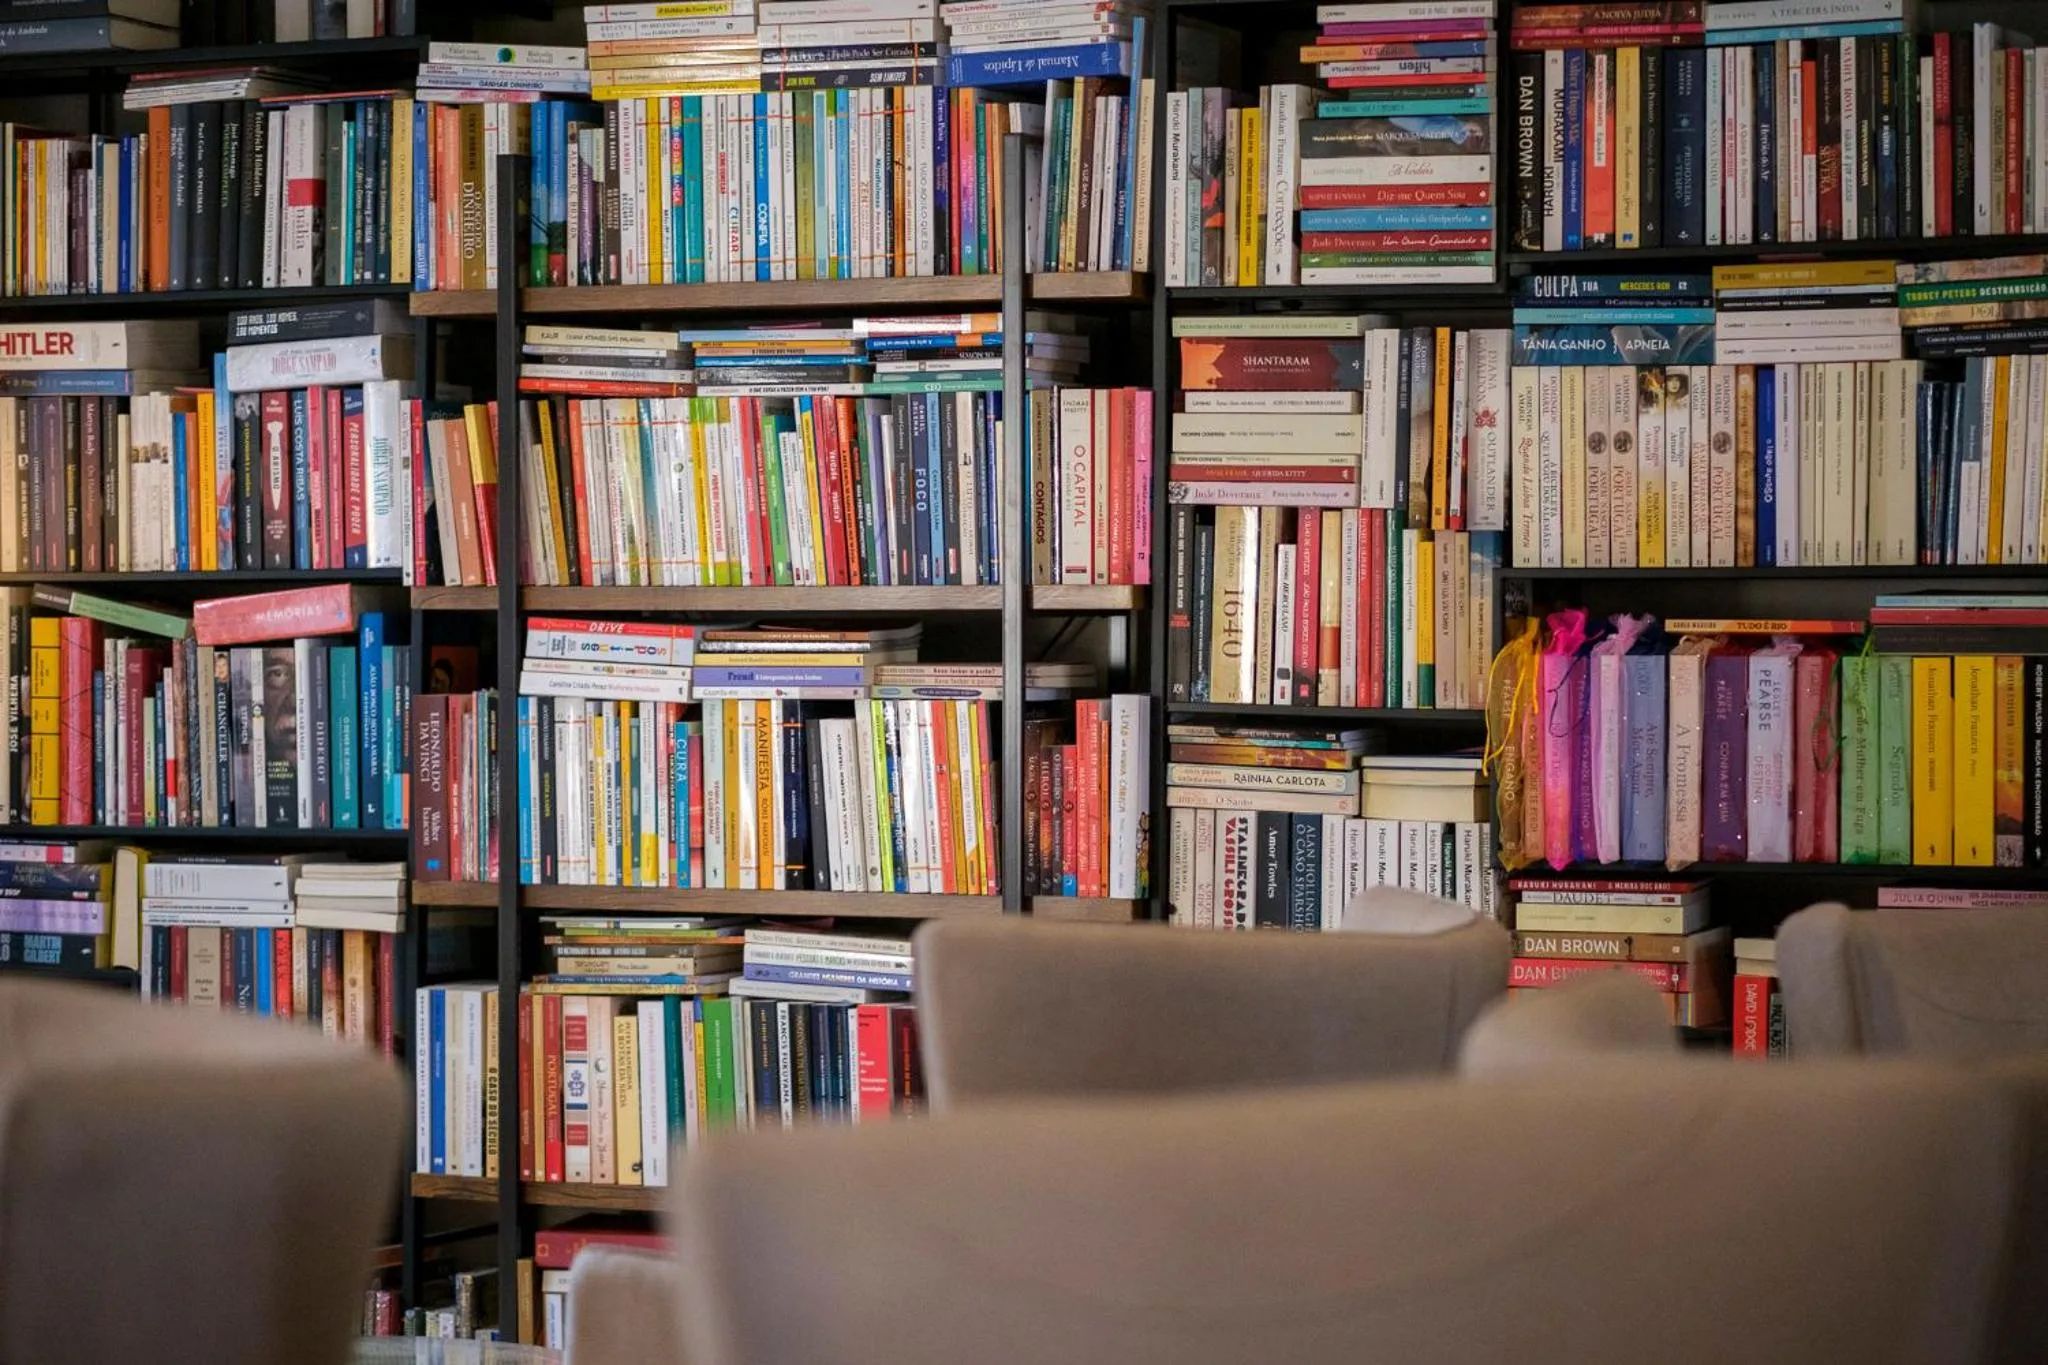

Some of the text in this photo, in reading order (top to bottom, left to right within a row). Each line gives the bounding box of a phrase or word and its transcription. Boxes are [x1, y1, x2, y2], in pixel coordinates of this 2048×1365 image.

[1519, 75, 1534, 178] DAN BROWN
[1553, 88, 1564, 163] MURAKAMI
[463, 181, 475, 259] DINHEIRO
[1543, 166, 1554, 218] HARUKI
[1534, 275, 1599, 298] CULPA TUA
[1242, 355, 1311, 367] SHANTARAM
[1559, 339, 1671, 351] GANHO APNEIA
[914, 467, 928, 512] FOCO
[1073, 461, 1087, 527] CAPITAL
[1486, 431, 1497, 512] OUTLANDER
[1587, 465, 1599, 541] PORTUGAL
[1034, 480, 1047, 545] CONTÁGIOS
[1612, 465, 1625, 543] PORTUGAL
[1712, 465, 1724, 545] PORTUGAL
[1221, 588, 1245, 659] 1640
[9, 674, 19, 723] VILHENA
[1758, 669, 1772, 732] PEARSE
[316, 721, 326, 784] DIDEROT
[430, 711, 441, 793] LEONARDO
[676, 739, 688, 783] CURA
[758, 716, 770, 792] MANIFESTA
[1233, 773, 1326, 787] RAINHA CARLOTA
[1503, 745, 1515, 801] ENGANO
[1676, 743, 1692, 822] Promessa
[1267, 827, 1279, 899] Amor Towles
[1295, 838, 1306, 872] CASO
[1306, 824, 1316, 858] ALAN
[1514, 964, 1547, 981] DAN
[1524, 938, 1620, 955] DAN BROWN
[547, 1054, 559, 1115] PORTUGAL
[778, 1009, 791, 1105] FRANCIS FUKUYAMA
[488, 1076, 497, 1103] CASO
